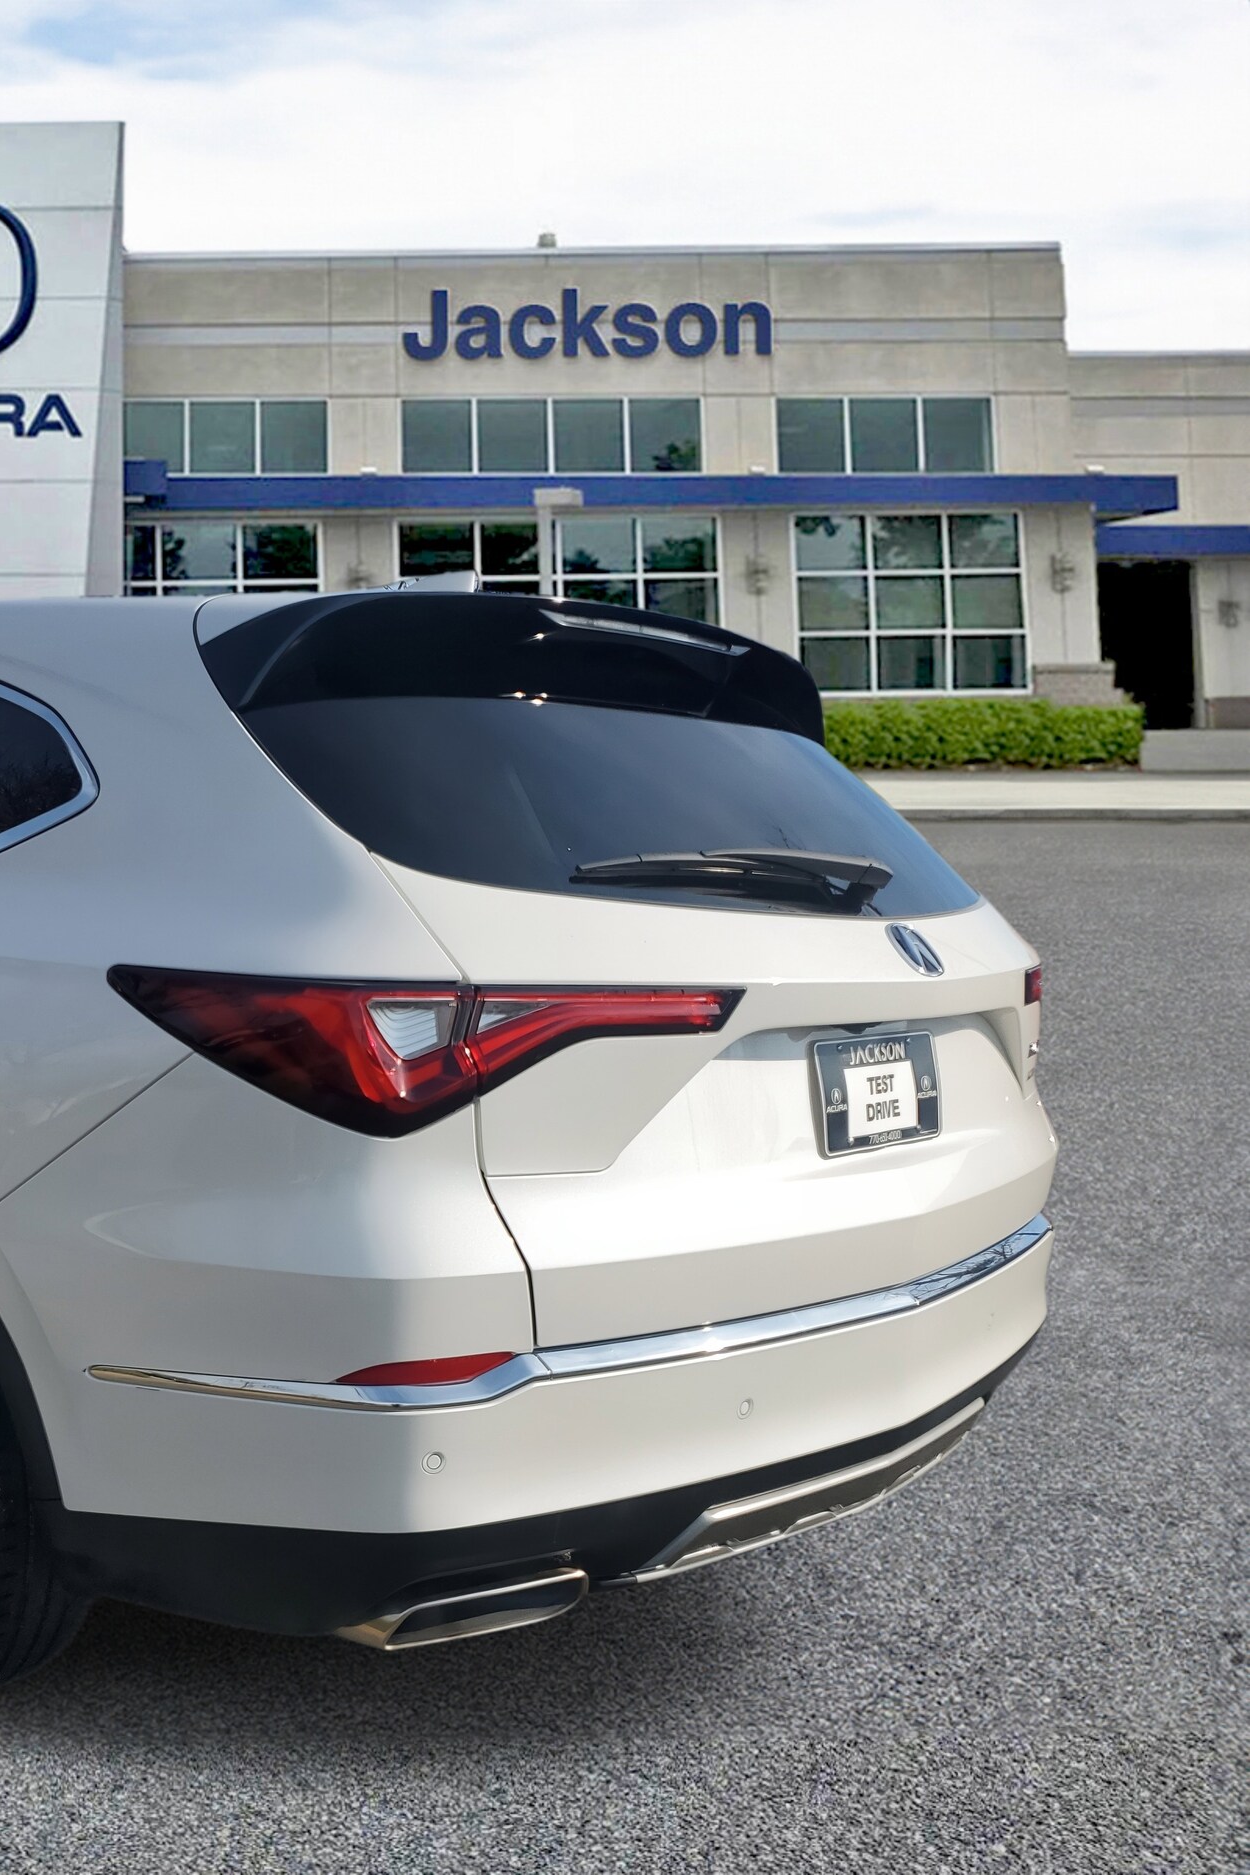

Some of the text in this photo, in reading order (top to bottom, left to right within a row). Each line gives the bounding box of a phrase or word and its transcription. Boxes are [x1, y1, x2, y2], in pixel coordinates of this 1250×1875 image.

[403, 288, 772, 360] Jackson
[850, 1041, 906, 1065] JACKSON
[867, 1074, 895, 1095] TEST
[826, 1104, 848, 1113] ACURA
[866, 1099, 900, 1121] DRIVE
